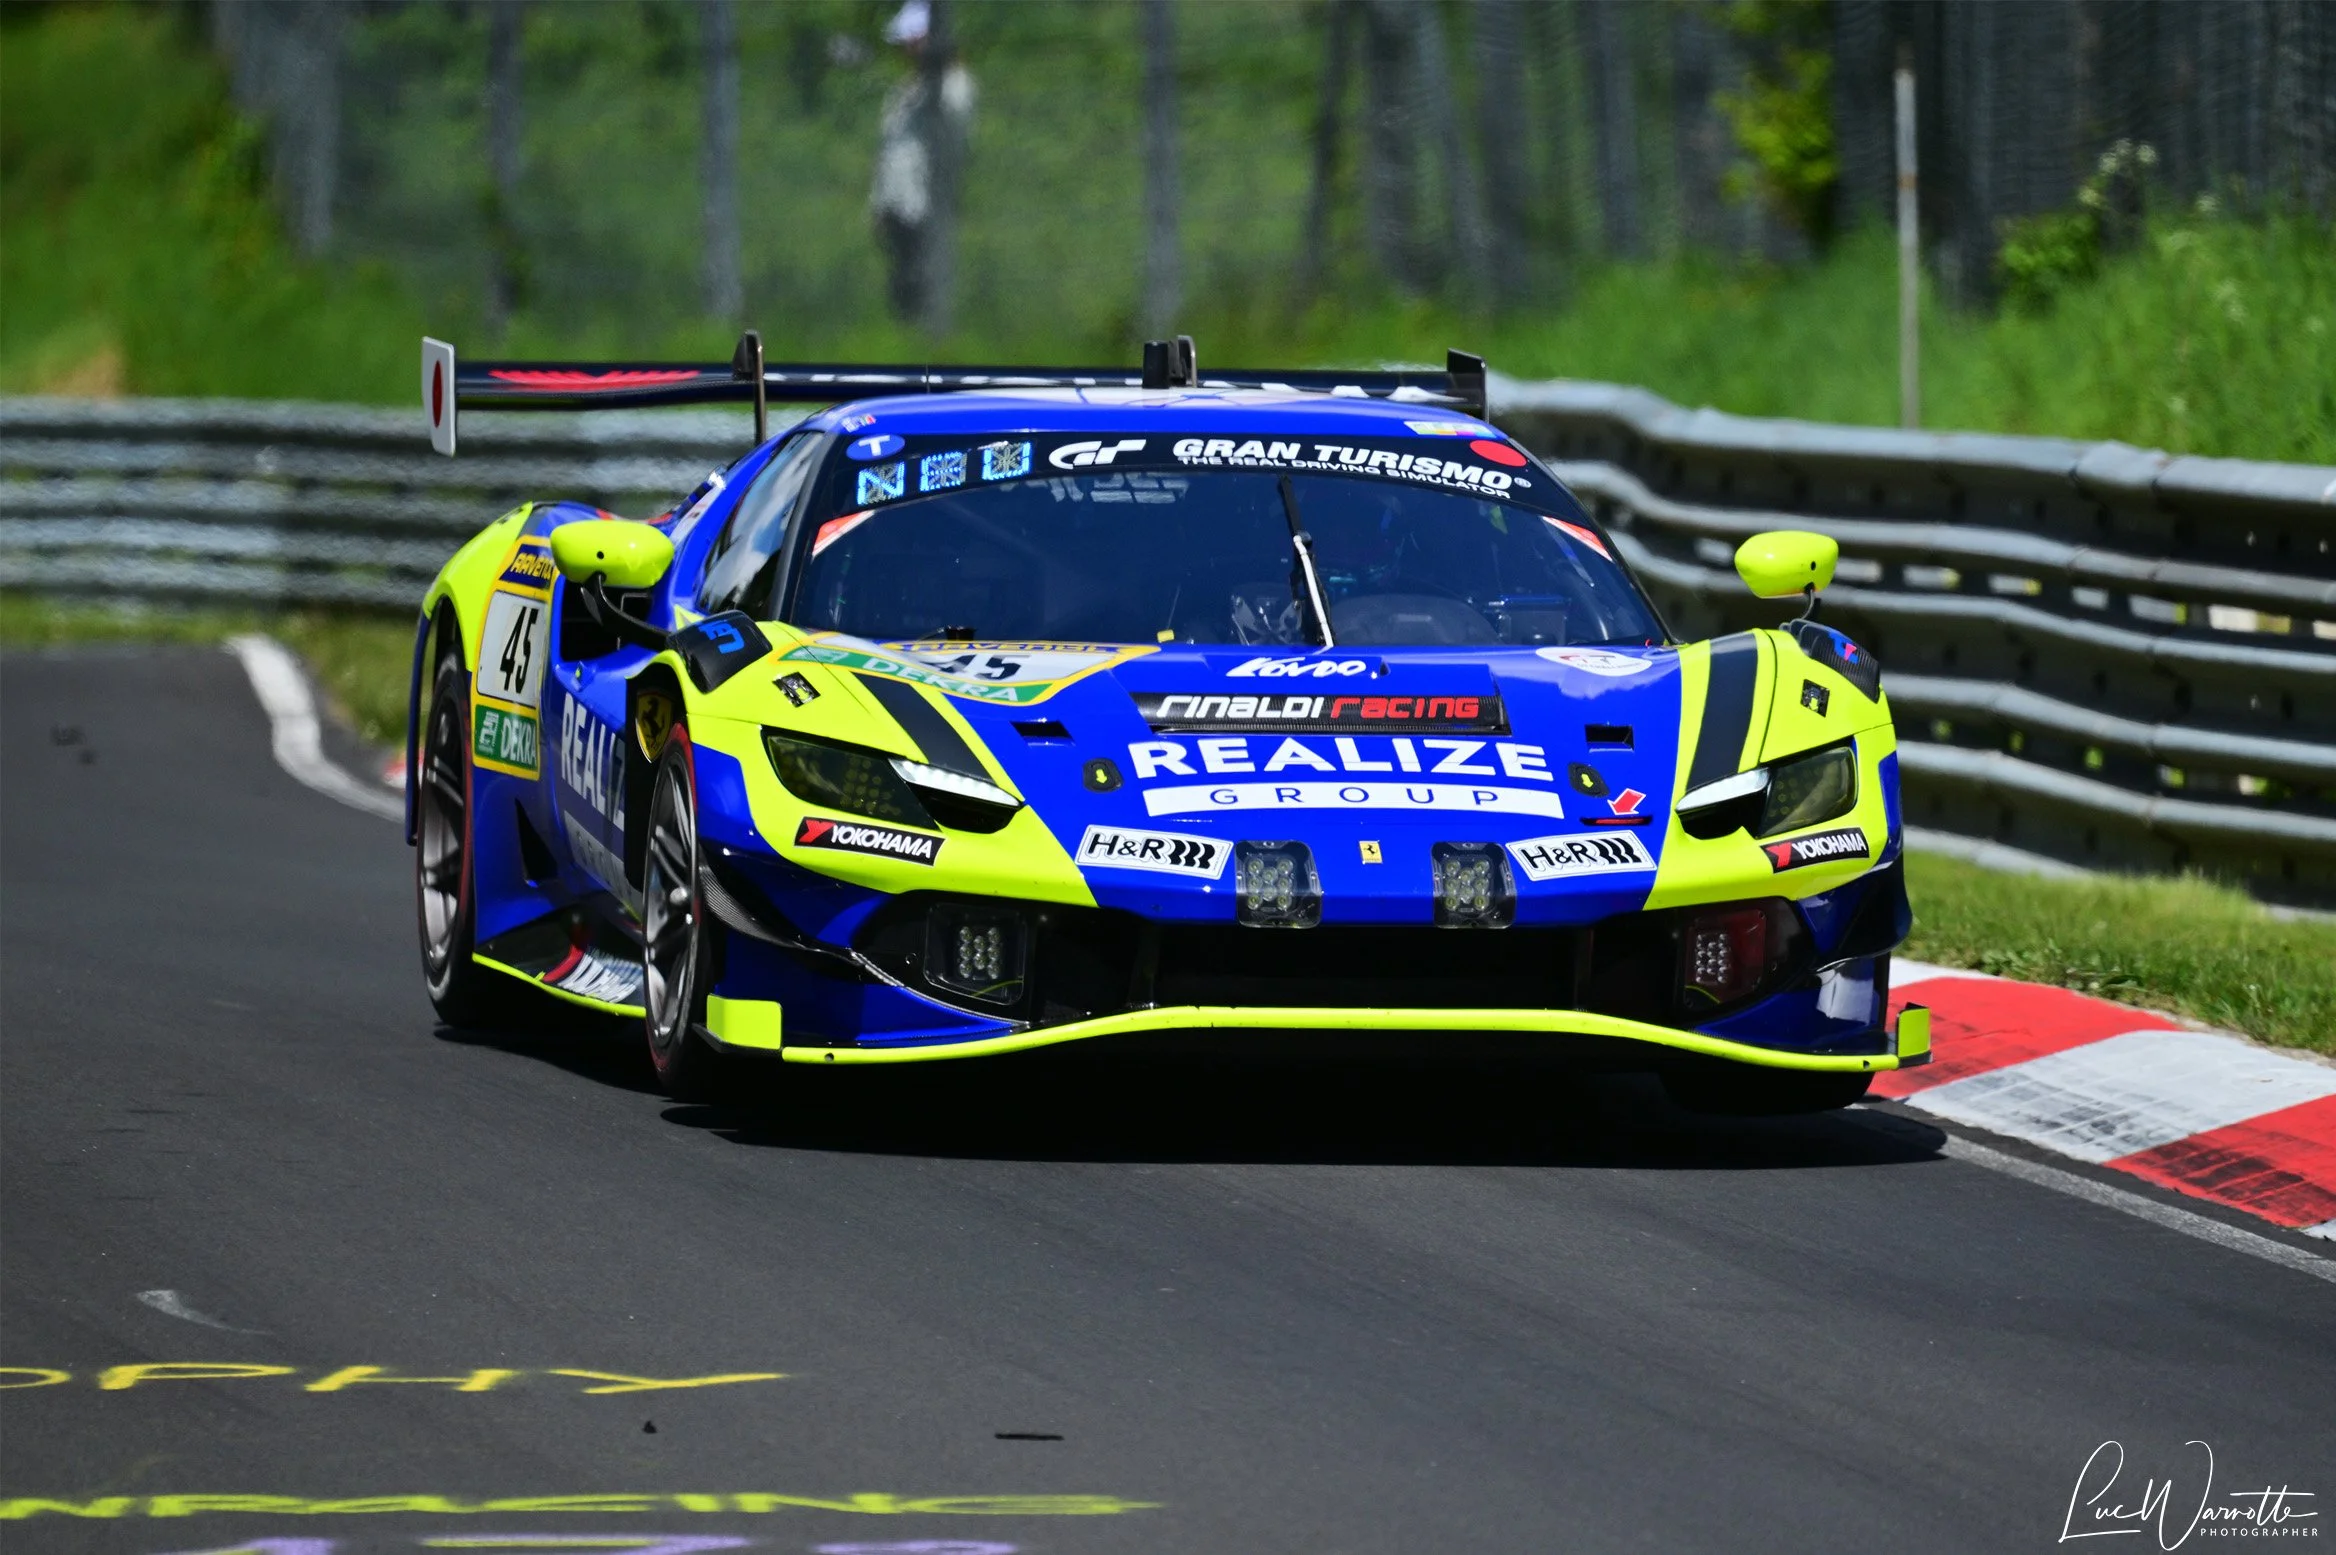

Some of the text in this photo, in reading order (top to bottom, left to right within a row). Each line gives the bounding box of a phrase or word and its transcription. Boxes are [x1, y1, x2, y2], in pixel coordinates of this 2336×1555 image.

[1172, 438, 1301, 461] GRAN
[1178, 456, 1512, 499] THE REAL DRIVING SIMULATOR
[499, 605, 540, 694] 45
[863, 658, 1019, 702] DEKRA
[501, 713, 538, 768] DEKRA
[1127, 736, 1555, 782] REALIZE
[561, 691, 626, 833] REALIZ
[1209, 786, 1499, 806] GROUP
[831, 824, 933, 859] YOKOHAMA
[1087, 833, 1165, 860] H&R
[1520, 842, 1598, 869] H&R
[1791, 832, 1867, 860] YOKOHAMA
